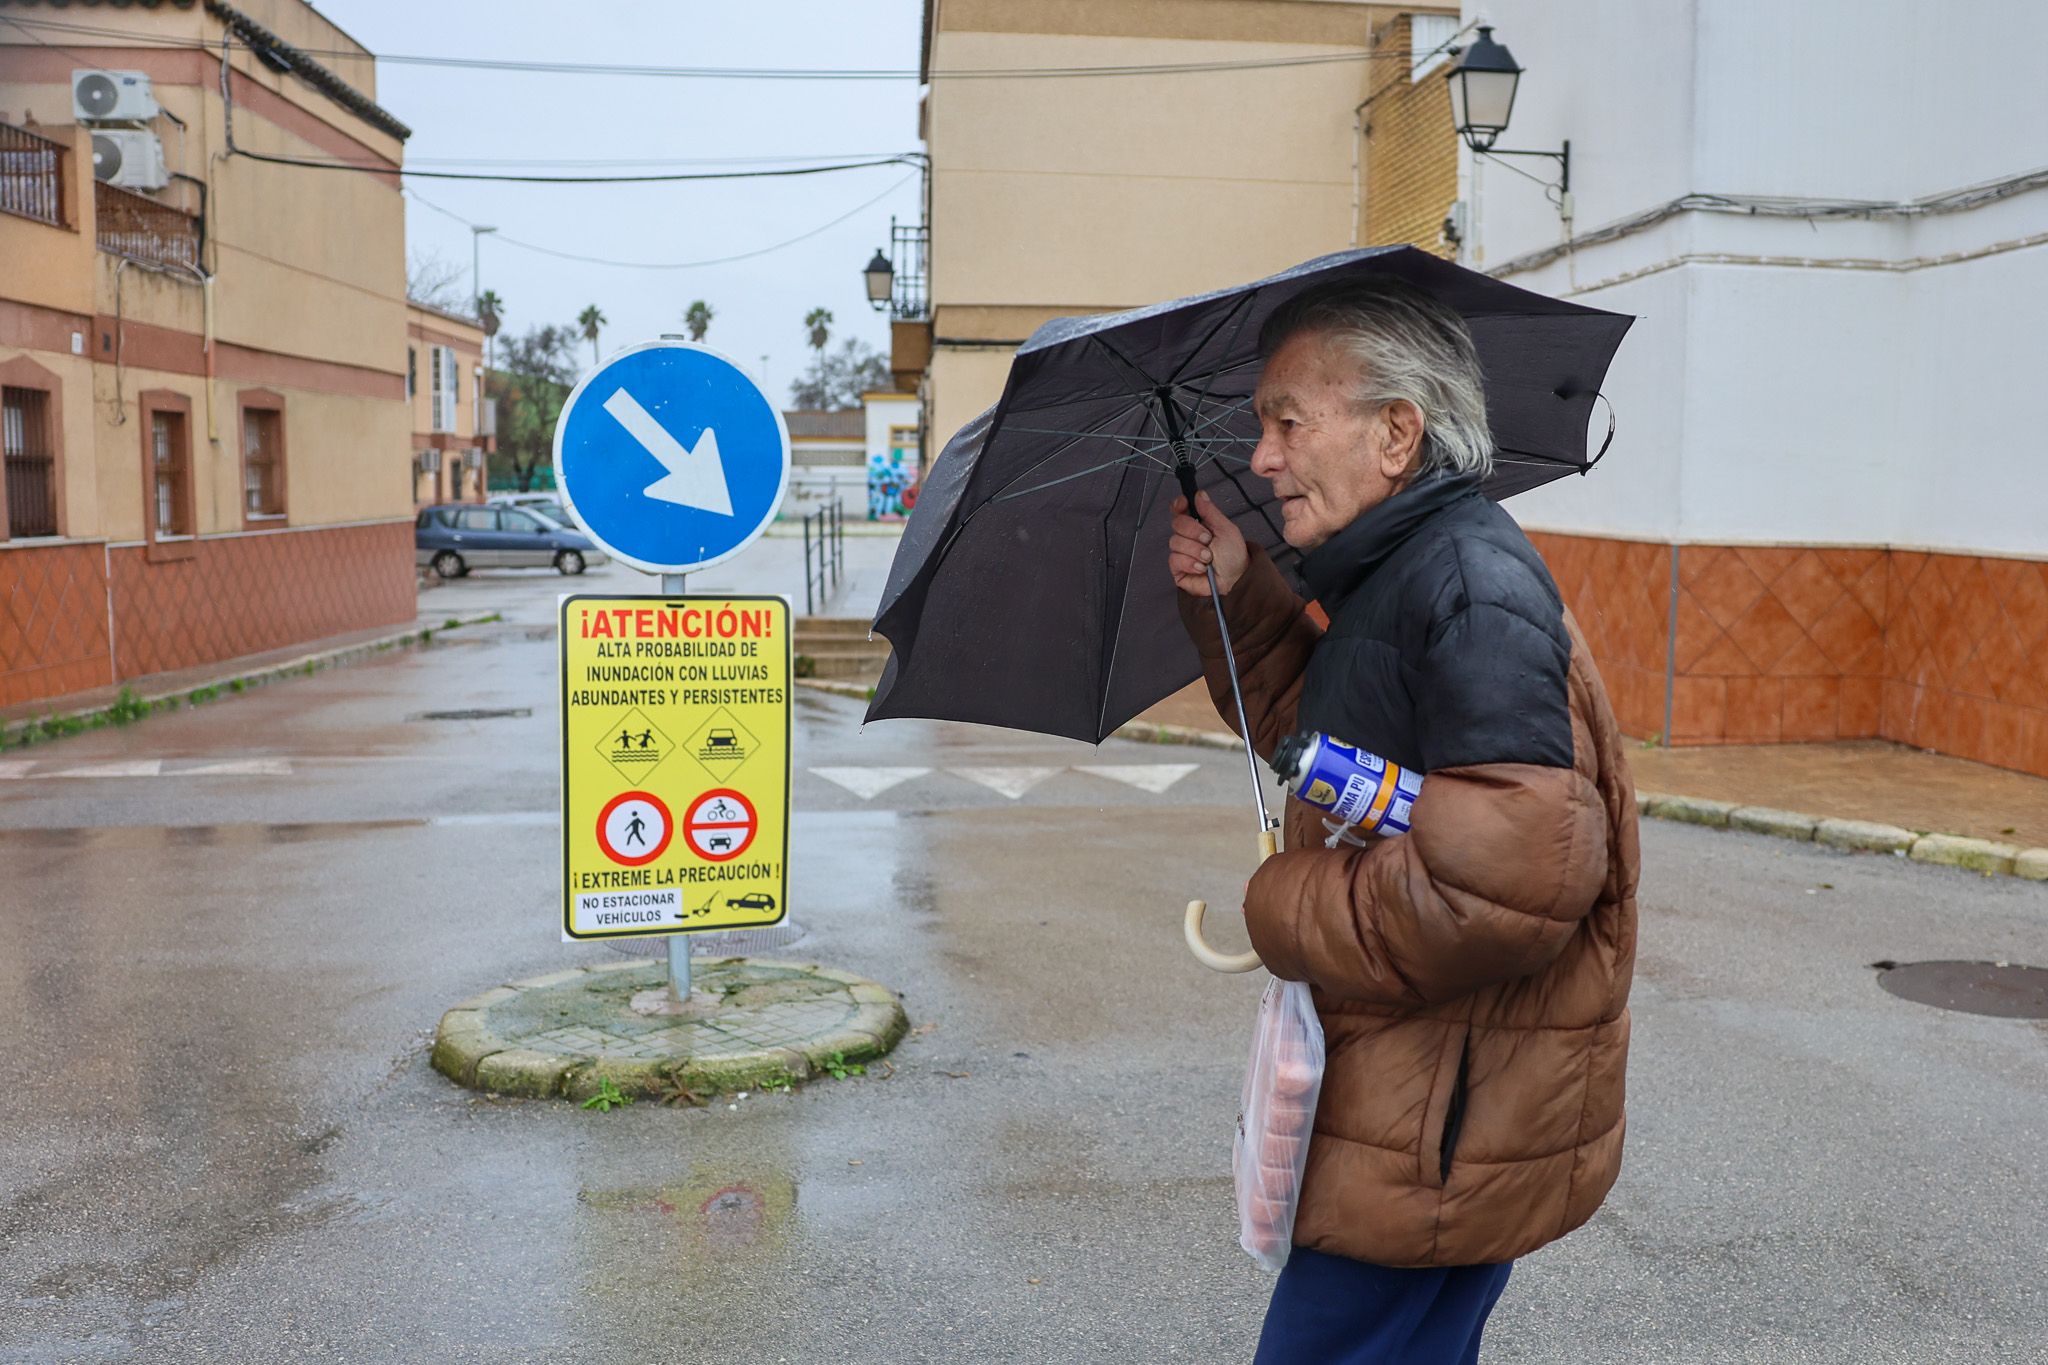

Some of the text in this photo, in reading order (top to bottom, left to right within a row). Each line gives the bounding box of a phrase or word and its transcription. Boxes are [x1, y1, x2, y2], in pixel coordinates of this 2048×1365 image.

[581, 603, 772, 638] ¡ATENCIÓN!
[597, 642, 757, 658] ALTA PROBABILIDAD DE
[587, 662, 768, 682] INUNDACIÓN CON LLUVIAS
[572, 688, 783, 706] ABUNDANTES Y PERSISTENTES
[1350, 776, 1366, 792] PU
[656, 868, 674, 885] LA
[582, 893, 675, 909] NO ESTACIONAR
[596, 908, 662, 925] VEHÍCULOS
